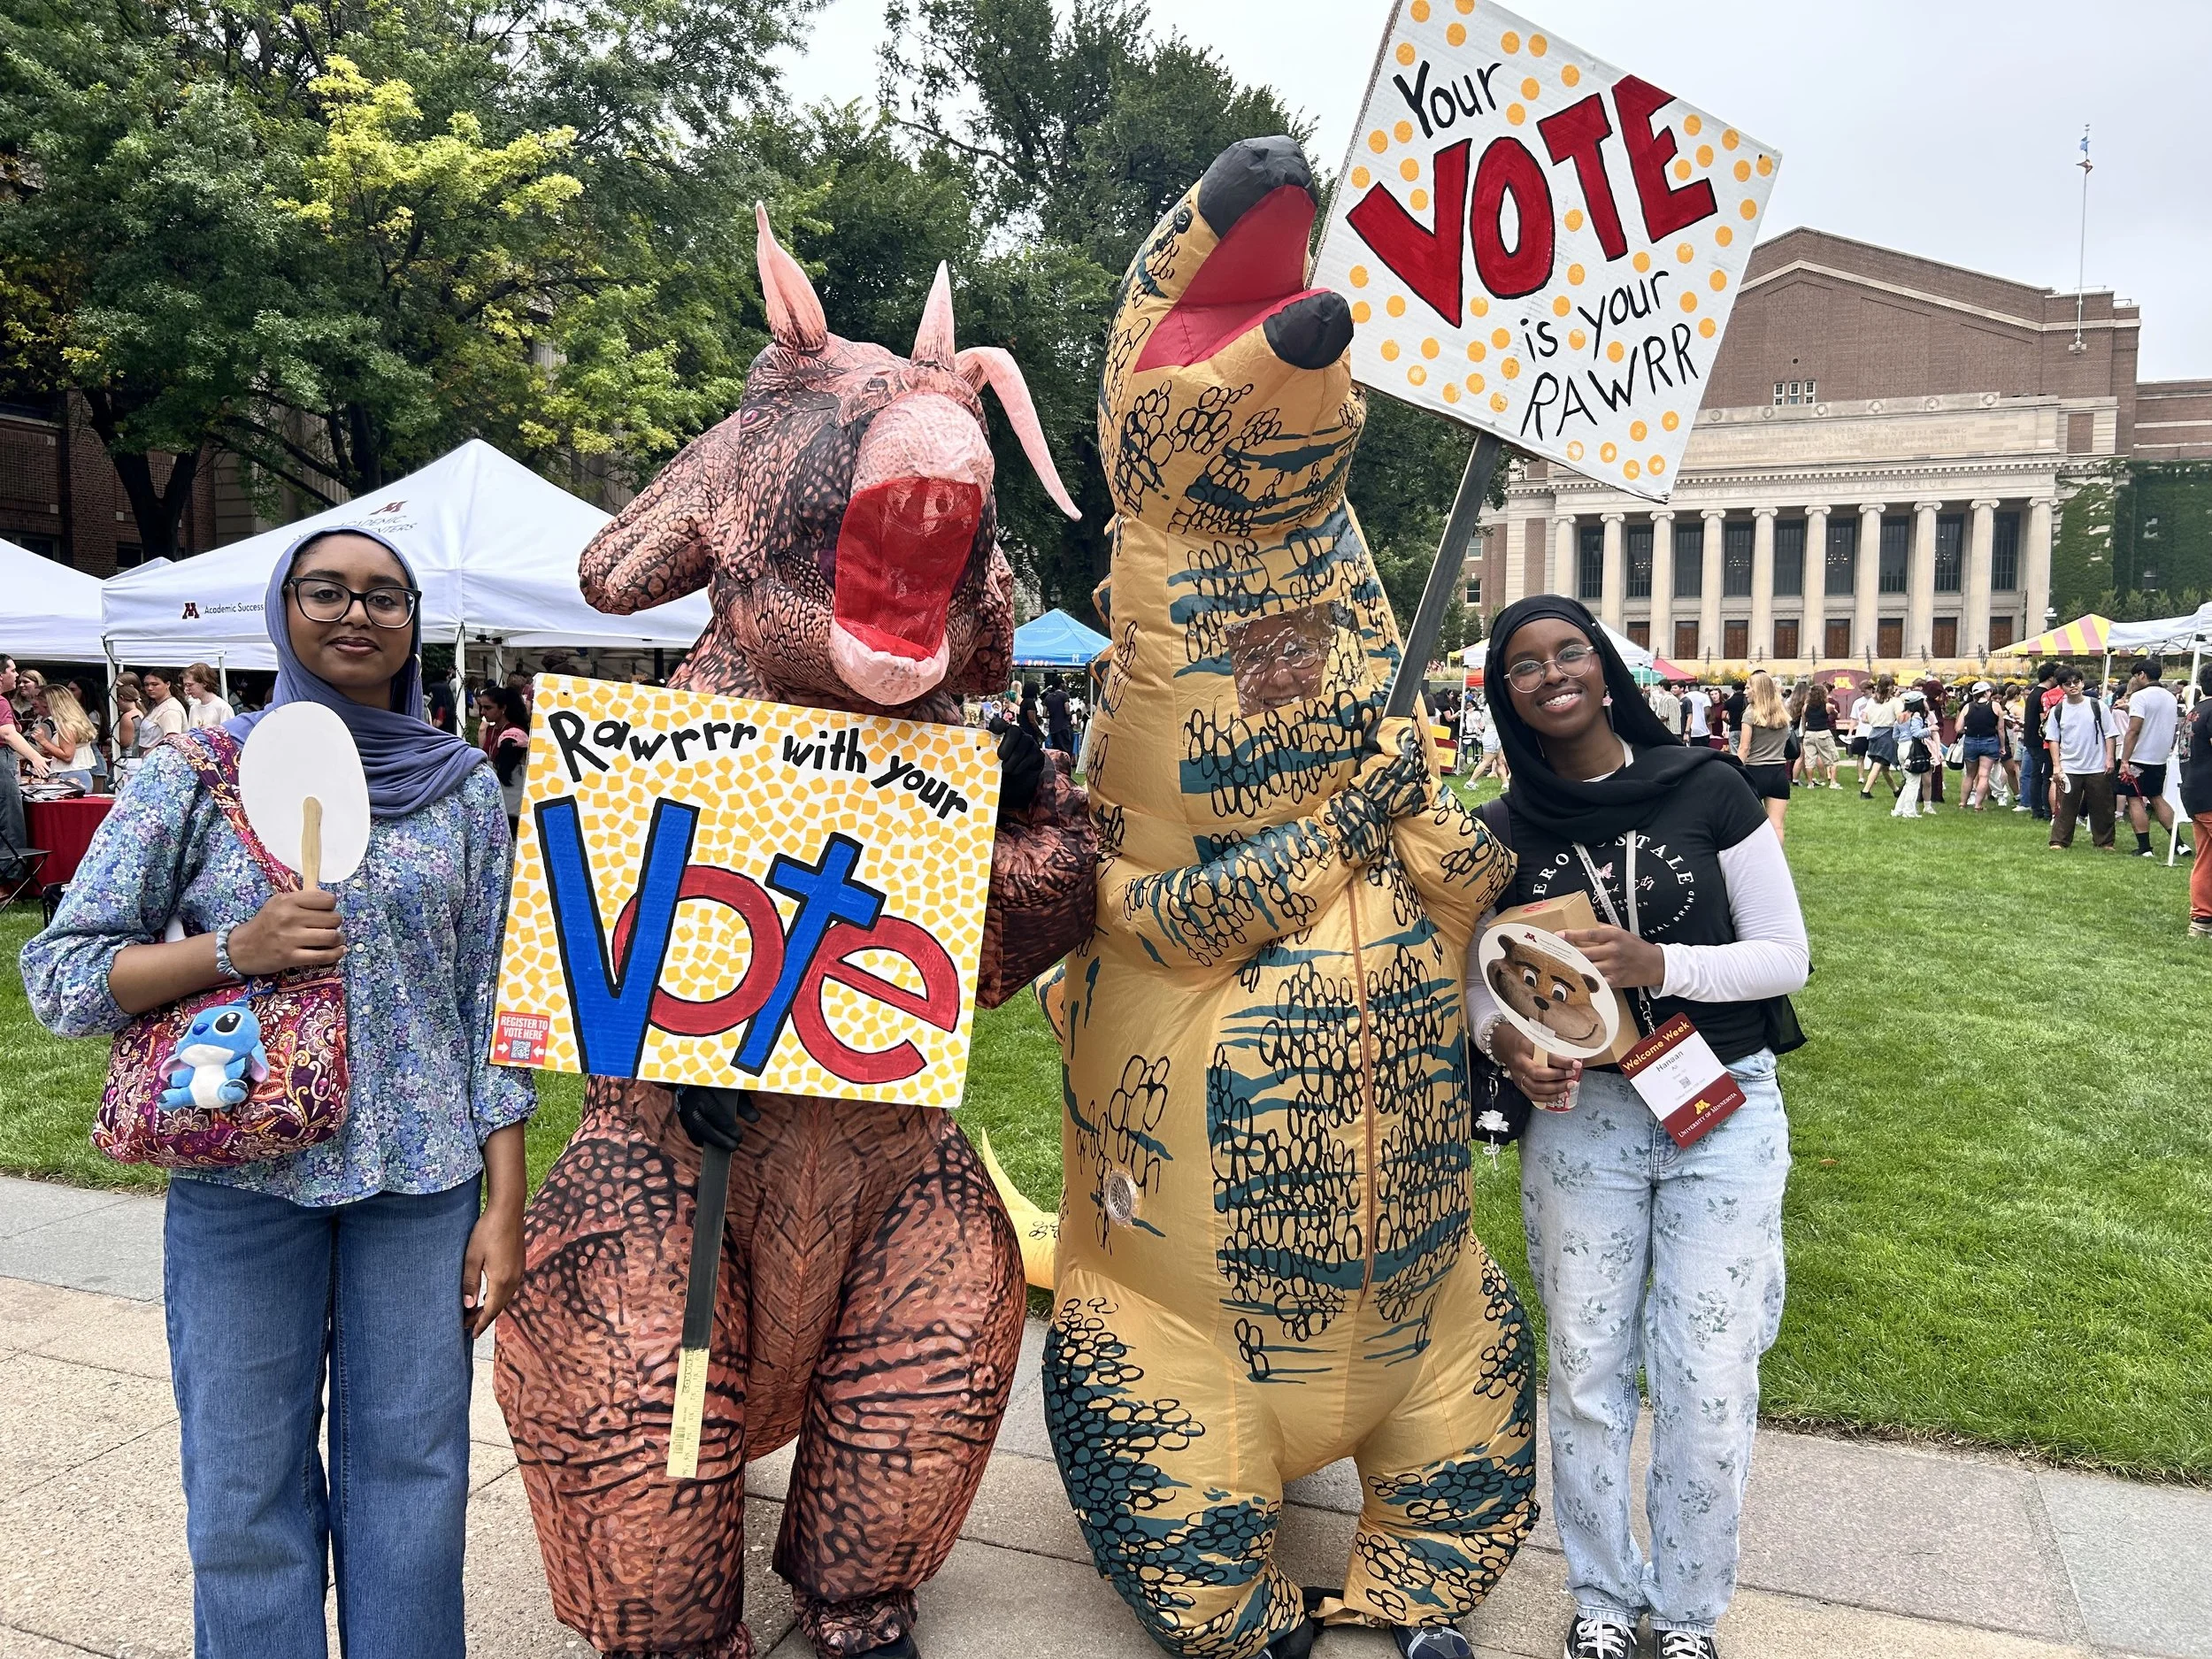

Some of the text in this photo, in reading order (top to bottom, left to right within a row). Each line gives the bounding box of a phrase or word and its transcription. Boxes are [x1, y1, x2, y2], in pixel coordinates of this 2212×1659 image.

[1393, 60, 1502, 139] Your
[1345, 73, 1718, 329] VOTE
[1519, 270, 1669, 363] is your
[1519, 322, 1699, 442] RAWRR
[1862, 480, 1948, 492] AUDITORIUM
[204, 603, 237, 614] Academic
[237, 603, 265, 612] Success
[548, 709, 969, 821] Rawrrr with your
[1601, 894, 1617, 926] UNIVERSIT
[1672, 889, 1695, 922] BRAND
[534, 795, 960, 1086] Vote
[500, 1015, 549, 1031] REGISTER TO
[503, 1026, 544, 1041] VOTE HERE
[1622, 1020, 1690, 1071] Welcome Week
[1655, 1049, 1685, 1072] Hanaan
[1678, 1092, 1738, 1139] UNIVERSITY OF MINNESOTA
